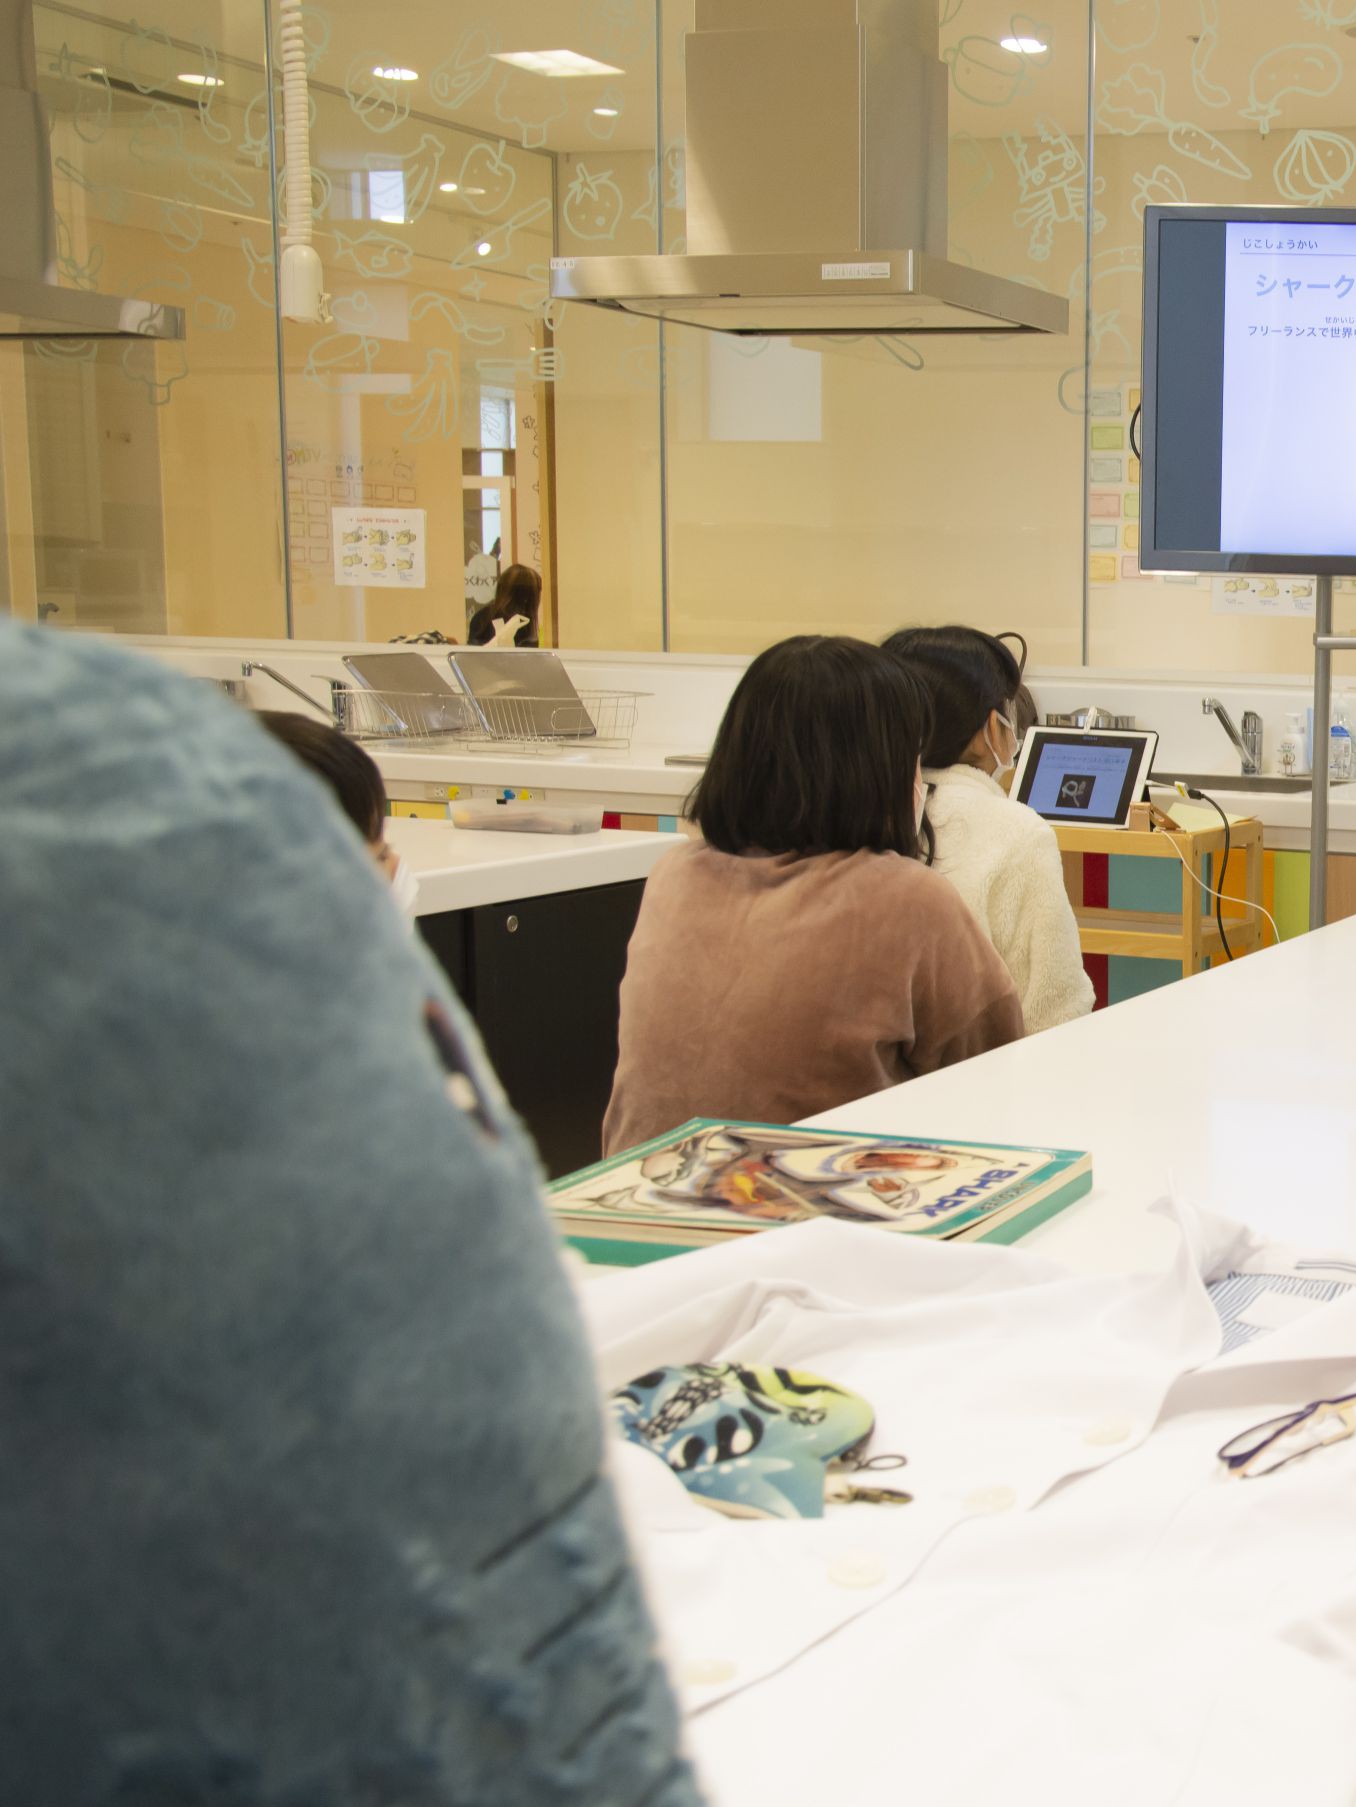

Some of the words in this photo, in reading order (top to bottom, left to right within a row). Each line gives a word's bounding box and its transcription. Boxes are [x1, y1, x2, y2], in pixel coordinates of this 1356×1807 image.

[1242, 238, 1319, 250] じこしょうかい
[918, 1168, 1019, 1218] SHARK
